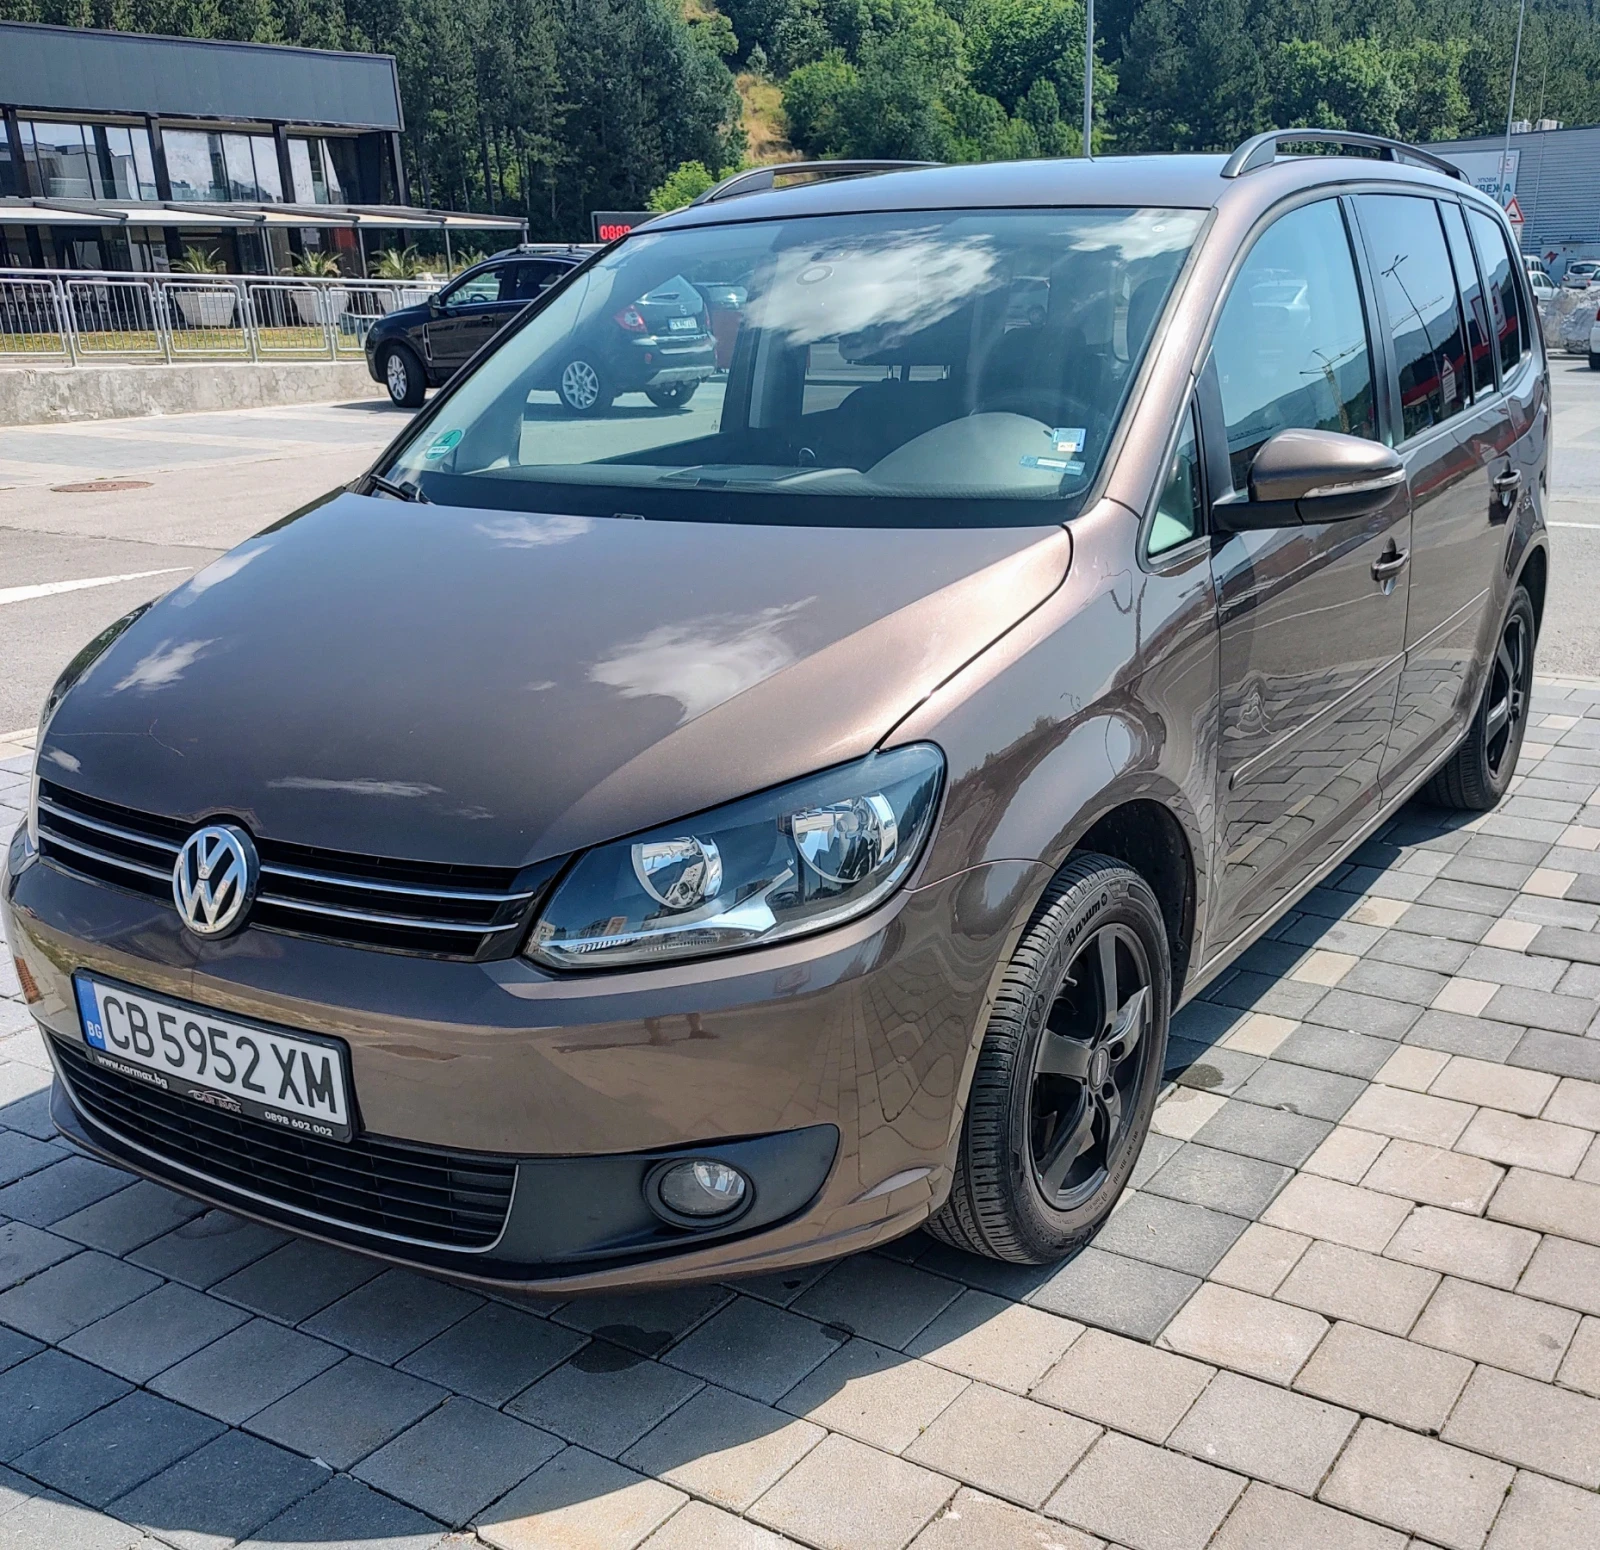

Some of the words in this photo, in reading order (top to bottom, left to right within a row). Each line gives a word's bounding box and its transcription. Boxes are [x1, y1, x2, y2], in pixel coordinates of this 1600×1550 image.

[87, 1021, 102, 1039] BG
[97, 1055, 168, 1090] www.carmax.bg
[264, 1111, 289, 1125] 0898
[291, 1118, 311, 1131] 602
[312, 1124, 333, 1137] 002
